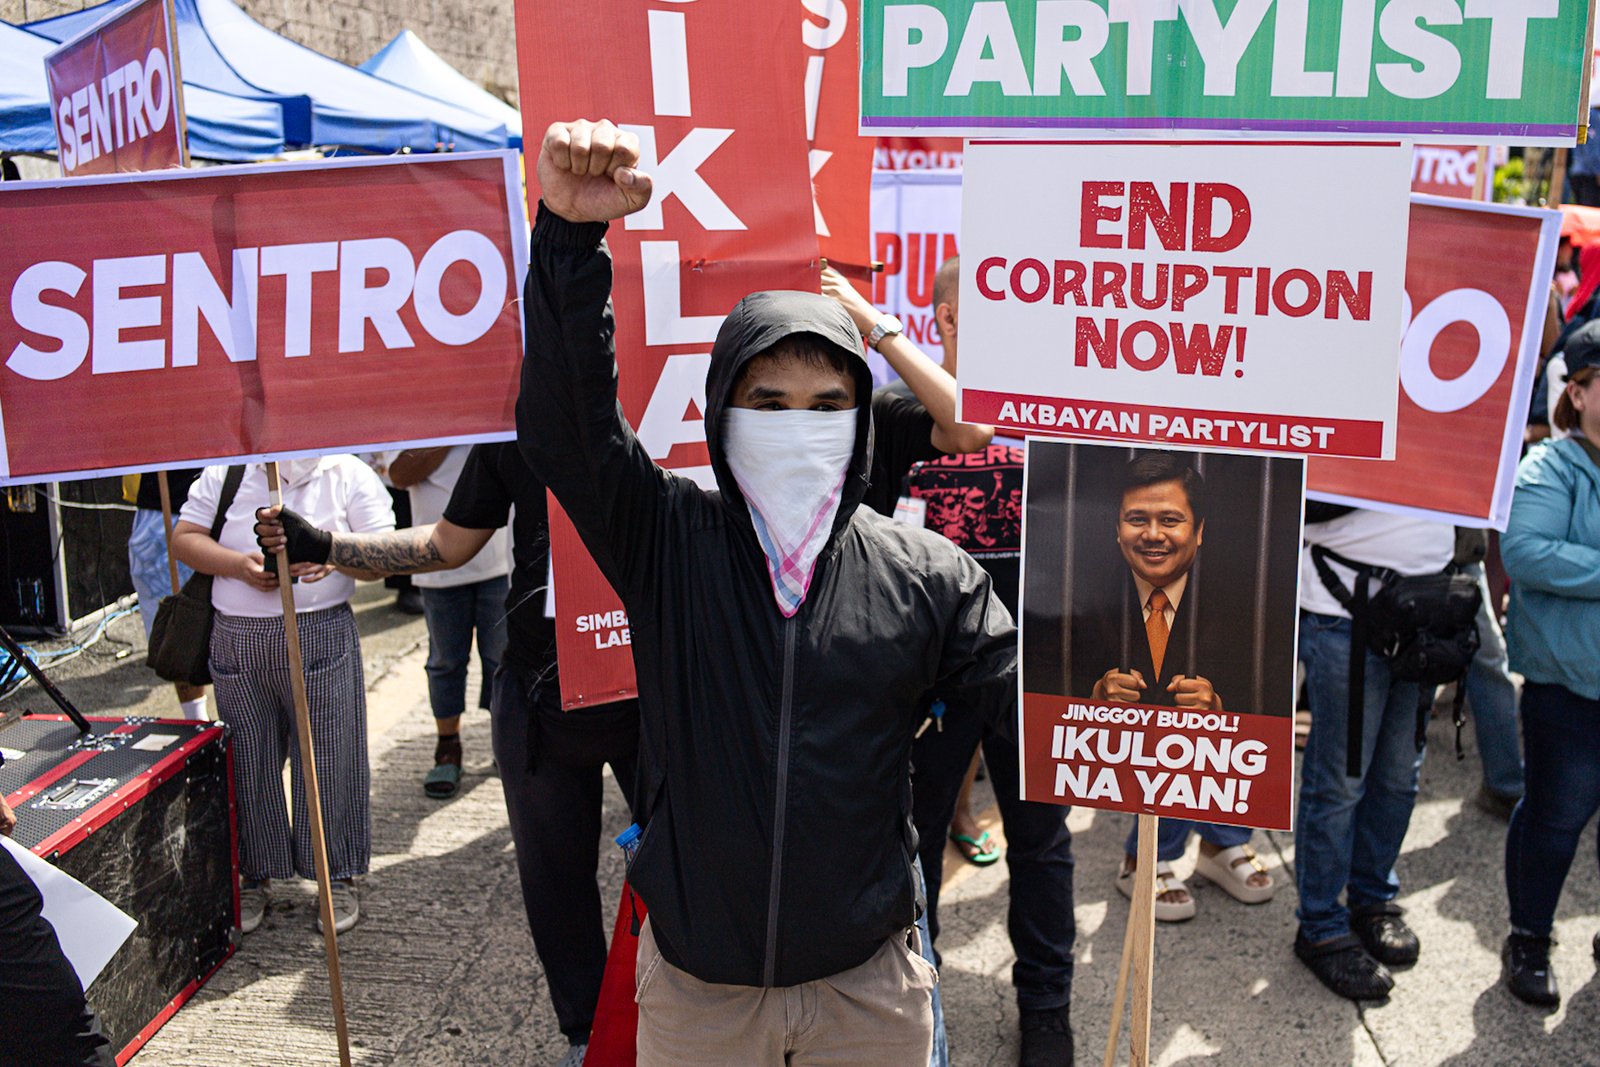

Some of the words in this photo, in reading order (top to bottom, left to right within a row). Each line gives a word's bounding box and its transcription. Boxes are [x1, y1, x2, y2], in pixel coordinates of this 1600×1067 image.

[881, 0, 1558, 99] PARTYLIST
[58, 47, 171, 172] SENTRO
[1411, 149, 1478, 188] TRO
[1079, 180, 1252, 254] END
[5, 230, 508, 381] SENTRO
[976, 256, 1374, 321] CORRUPTION
[1074, 316, 1248, 379] NOW!
[998, 401, 1140, 435] AKBAYAN
[1148, 413, 1336, 450] PARTYLIST
[1061, 703, 1155, 726] JINGGOY
[1156, 710, 1240, 733] BUDOL!
[1051, 725, 1268, 776] IKULONG
[1054, 763, 1123, 803] NA
[1134, 770, 1252, 815] YAN!
